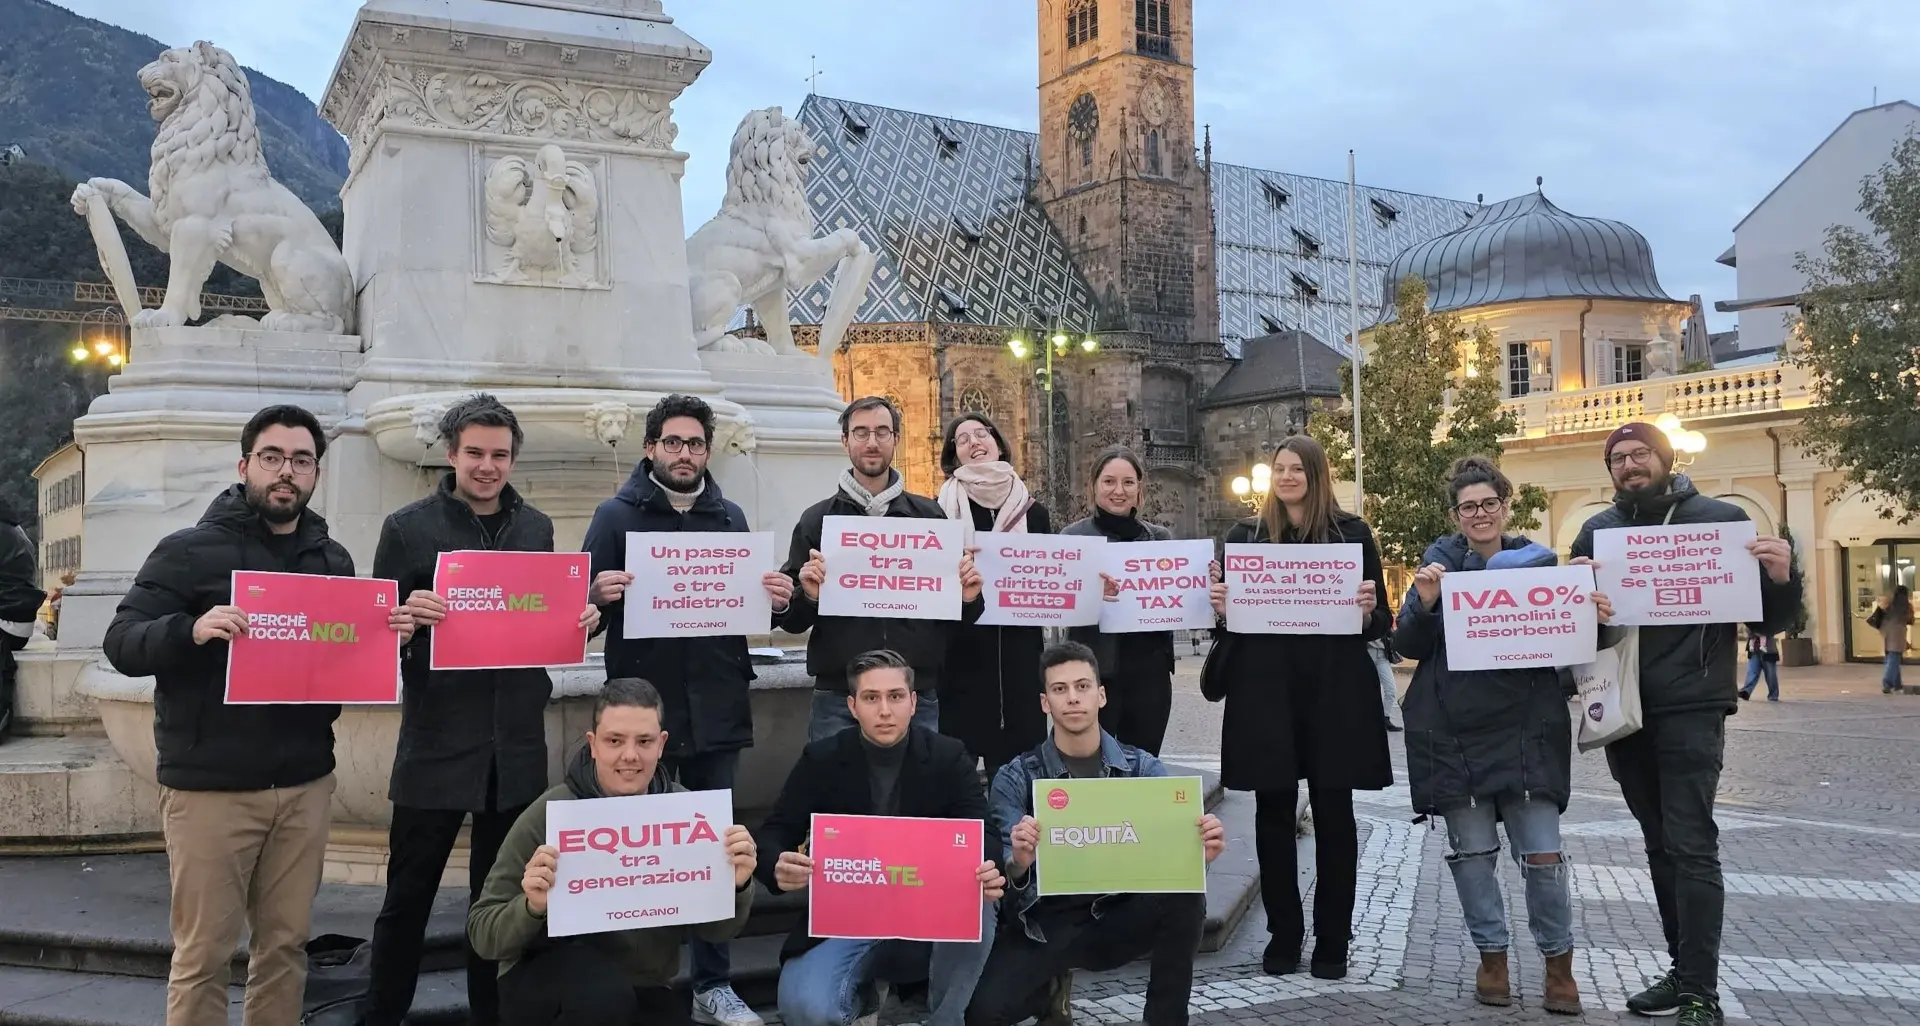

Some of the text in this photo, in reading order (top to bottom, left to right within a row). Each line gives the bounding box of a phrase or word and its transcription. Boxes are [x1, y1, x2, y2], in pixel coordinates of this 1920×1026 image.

[841, 530, 943, 550] EQUITÀ
[1627, 529, 1720, 545] Non puoi
[651, 546, 750, 561] Un passo
[1000, 547, 1081, 560] Cura dei
[1626, 546, 1722, 560] scegliere
[667, 562, 734, 575] avanti
[869, 555, 912, 570] tra
[1124, 557, 1189, 572] STOP
[1230, 558, 1356, 570] NO aumento
[1629, 559, 1721, 574] se usarli.
[1011, 564, 1067, 577] corpi,
[674, 580, 726, 592] e tre
[839, 574, 942, 592] GENERI
[994, 577, 1082, 591] diritto di
[1242, 574, 1276, 584] IVA
[1281, 574, 1296, 584] al
[1621, 573, 1733, 588] Se tassarli
[448, 585, 502, 599] PERCHÈ
[1263, 587, 1331, 595] assorbenti
[1452, 585, 1585, 611] IVA 0%
[1658, 588, 1695, 604] SI!
[447, 594, 548, 612] TOCCA A ME.
[652, 596, 744, 609] indietro!
[1136, 595, 1183, 609] TAX
[1233, 598, 1354, 606] coppette mestruali
[248, 612, 307, 627] PERCHÈ
[1468, 609, 1571, 626] pannolini e
[248, 622, 360, 643] TOCCA A NOI.
[1466, 622, 1576, 638] assorbenti
[558, 812, 719, 854] EQUITÀ
[1050, 821, 1140, 848] EQUITÀ
[620, 854, 660, 867] tra
[824, 858, 882, 872] PERCHÈ
[568, 866, 711, 894] generazioni
[824, 866, 924, 887] TOCCA A TE.
